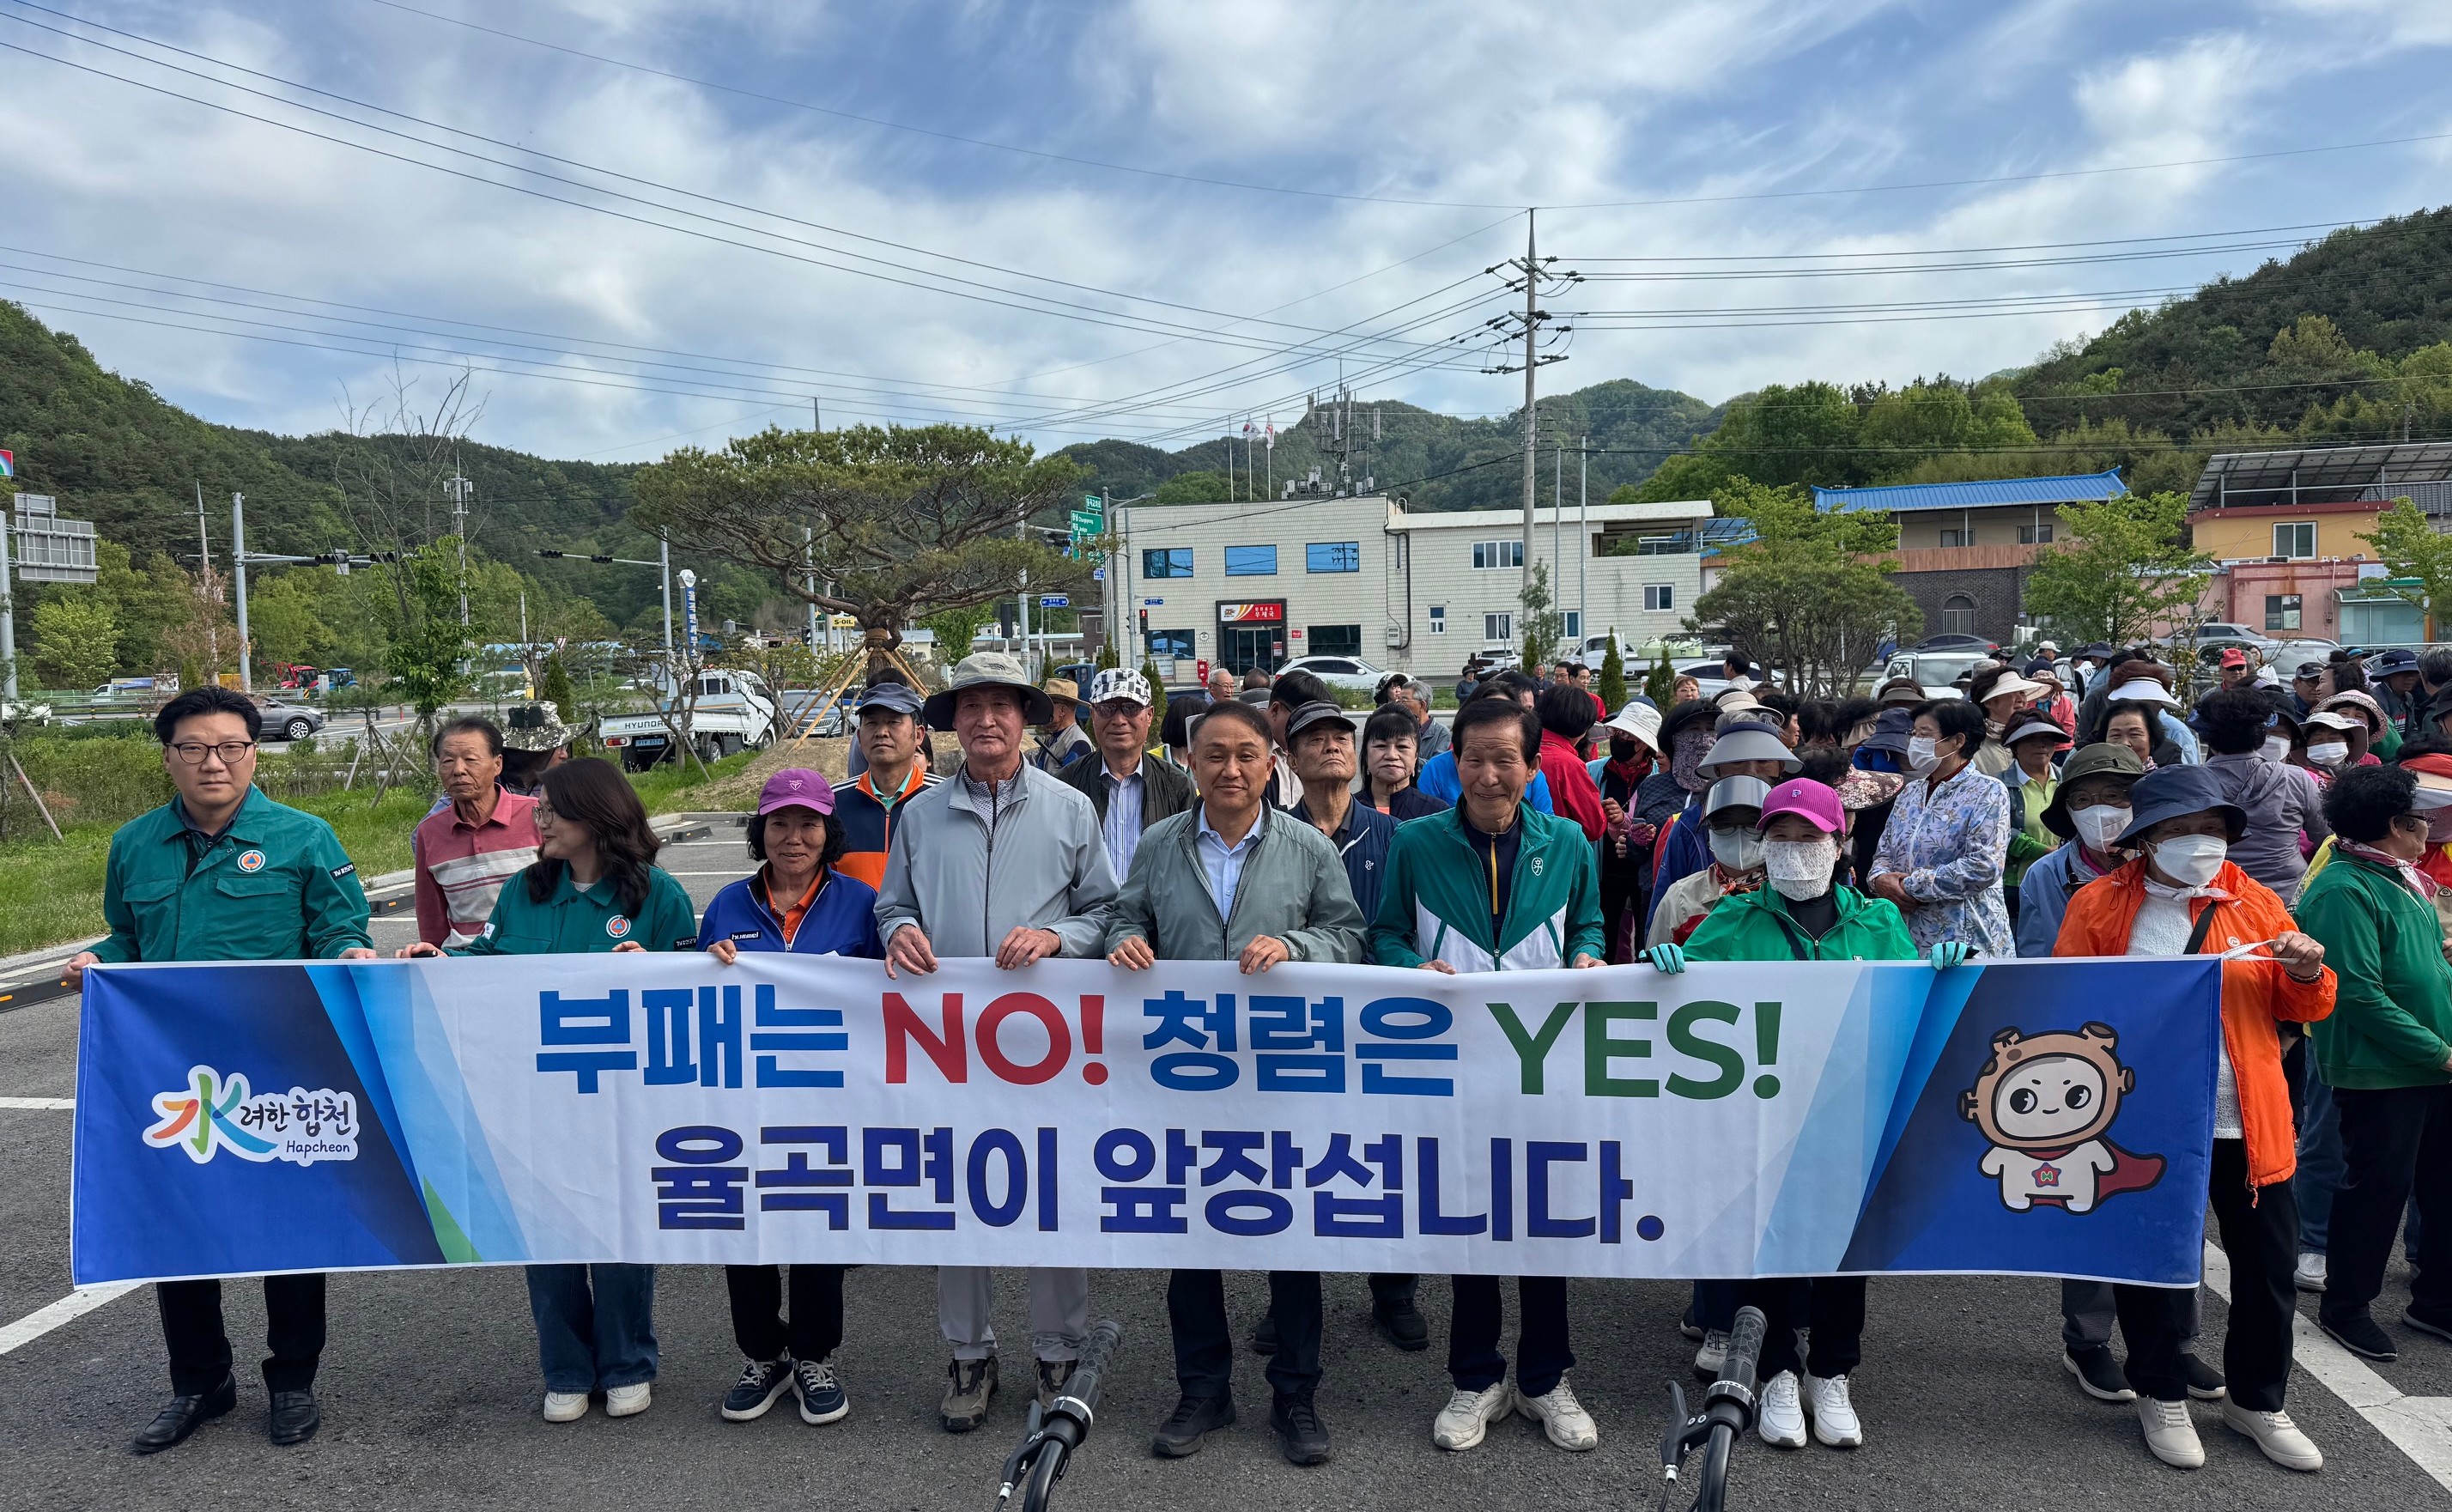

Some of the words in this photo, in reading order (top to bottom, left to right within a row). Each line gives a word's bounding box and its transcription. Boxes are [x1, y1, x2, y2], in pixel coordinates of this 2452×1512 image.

[625, 720, 667, 730] HYUNDA
[1792, 789, 1802, 798] P
[536, 984, 848, 1094] 부패는
[882, 992, 1109, 1086] NO!
[1142, 989, 1459, 1097] 청렴은
[1485, 1000, 1783, 1101] YES!
[291, 1094, 351, 1137] 합천
[286, 1139, 351, 1158] Hapcheon
[651, 1125, 1059, 1232] 율곡면이
[1093, 1127, 1665, 1245] 앞장섭니다.
